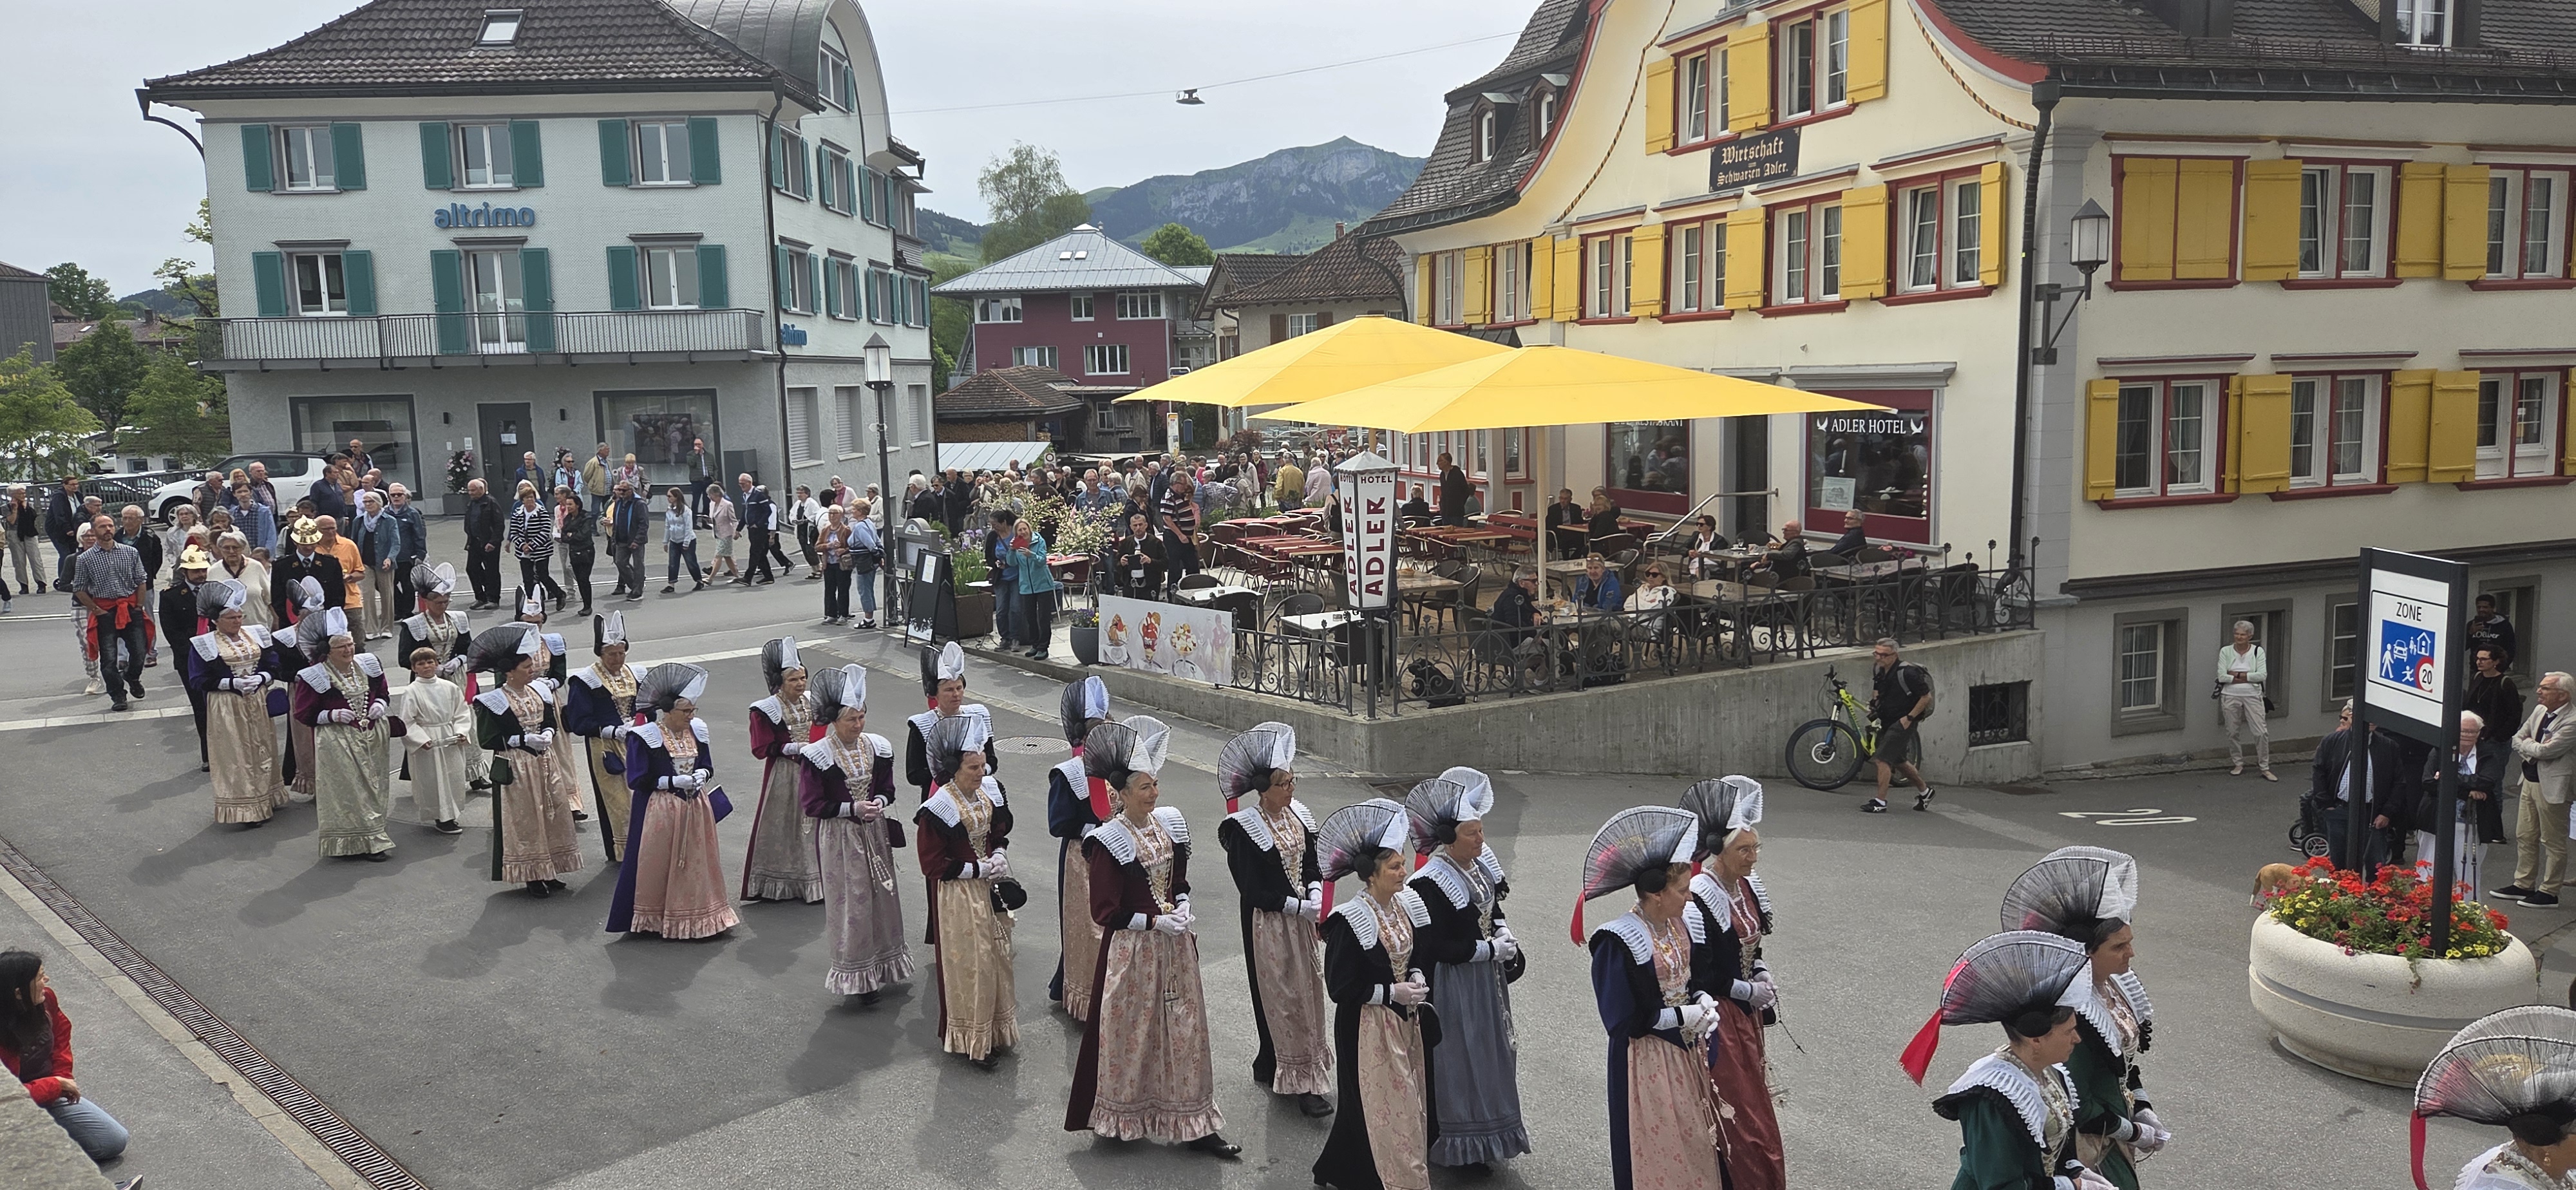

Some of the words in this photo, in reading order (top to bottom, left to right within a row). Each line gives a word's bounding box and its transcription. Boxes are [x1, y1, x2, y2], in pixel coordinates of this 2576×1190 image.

[1721, 136, 1784, 165] Wirtschaft
[1717, 168, 1761, 187] Schwarzen
[1763, 160, 1788, 177] Adler.
[434, 202, 535, 229] altrimo
[1831, 419, 1866, 433] ADLER
[1869, 419, 1906, 434] HOTEL
[1361, 475, 1392, 484] HOTEL
[1343, 496, 1358, 597] ADLER
[1365, 496, 1385, 596] ADLER
[2396, 601, 2422, 622] ZONE
[2421, 668, 2432, 685] 20
[2058, 809, 2197, 826] 20
